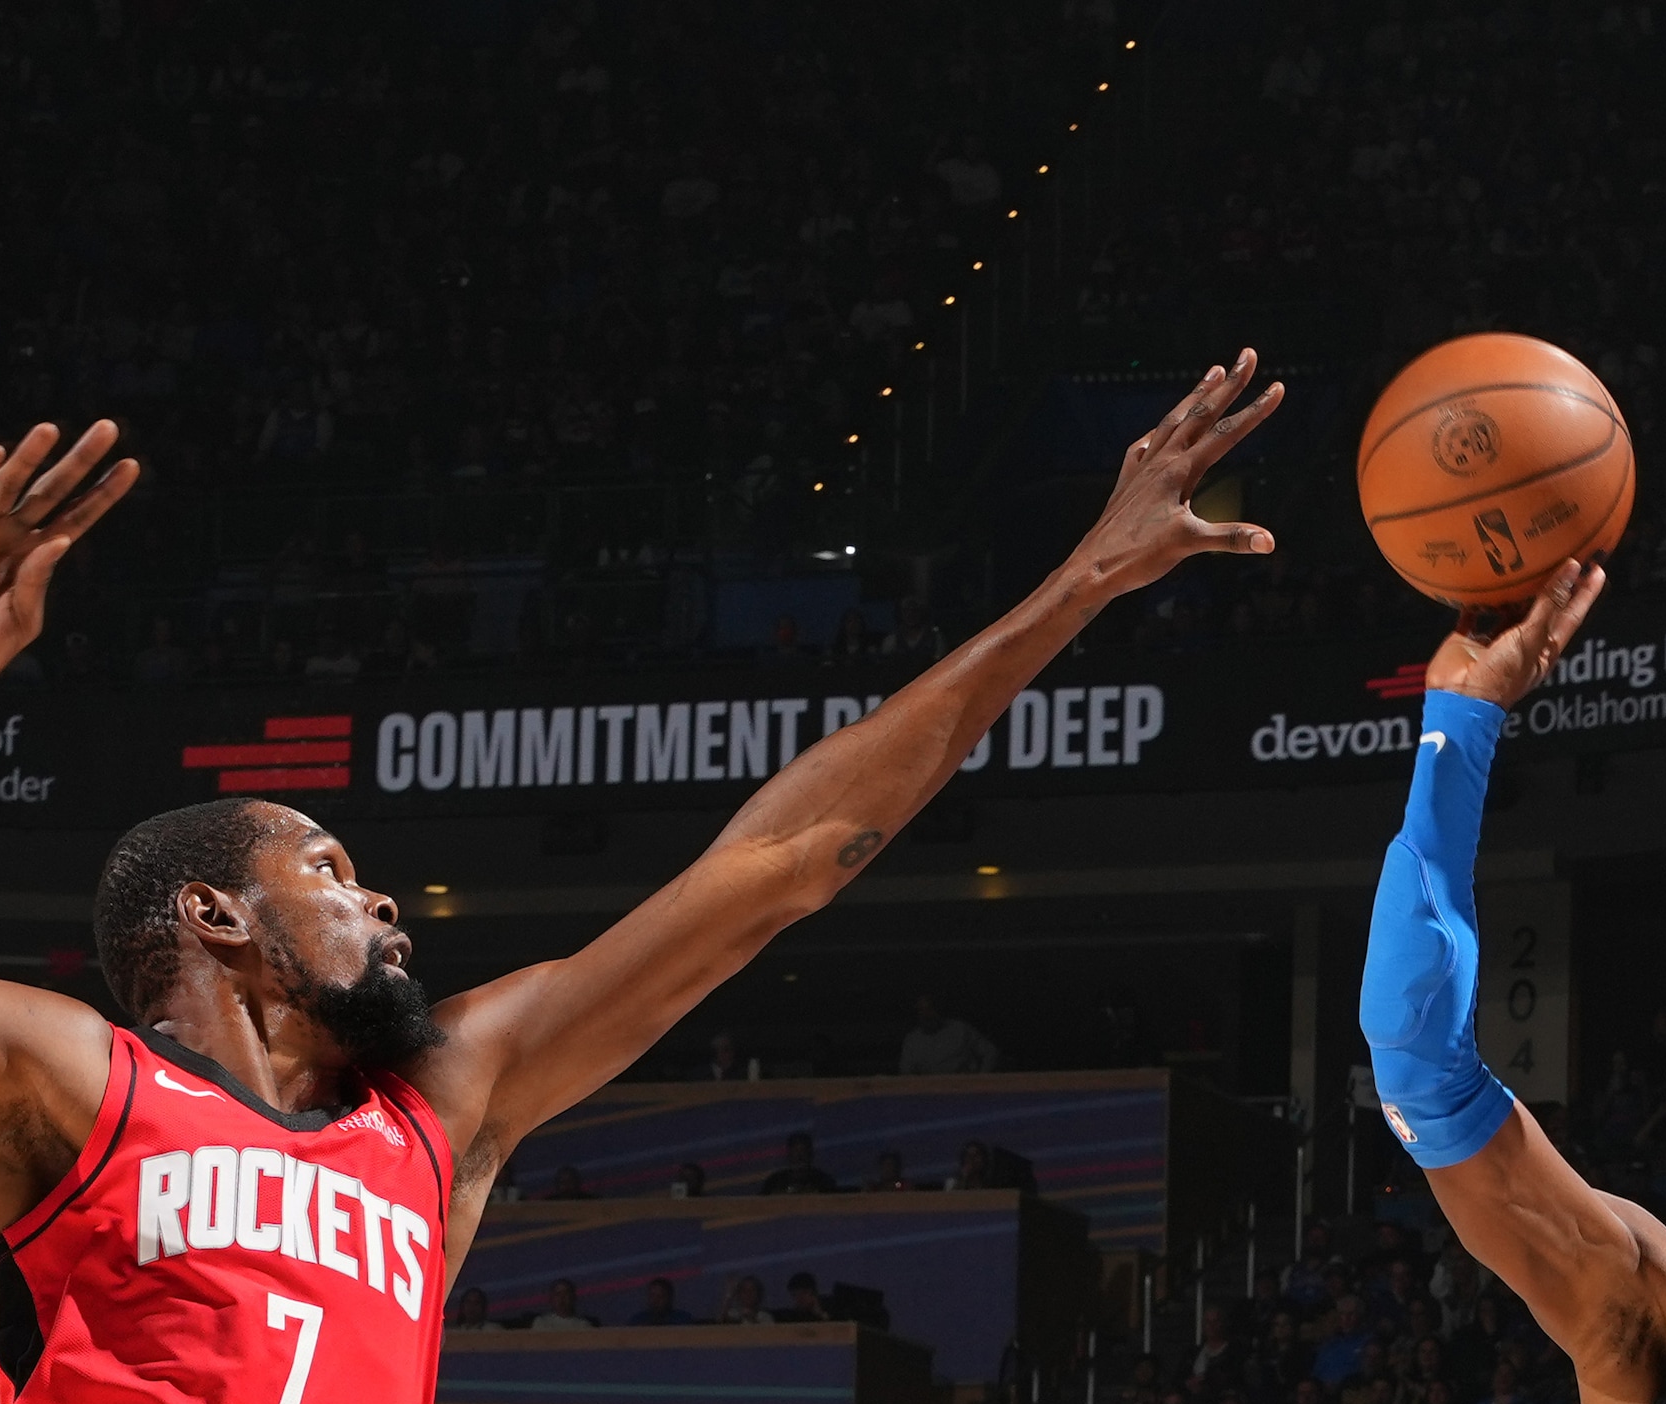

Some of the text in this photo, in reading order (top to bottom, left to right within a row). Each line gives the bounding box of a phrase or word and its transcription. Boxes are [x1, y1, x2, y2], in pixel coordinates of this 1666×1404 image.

[376, 697, 809, 793] COMMITMENT
[1007, 684, 1165, 770] DEEP
[1250, 714, 1411, 762] devon
[137, 1145, 430, 1322] ROCKETS
